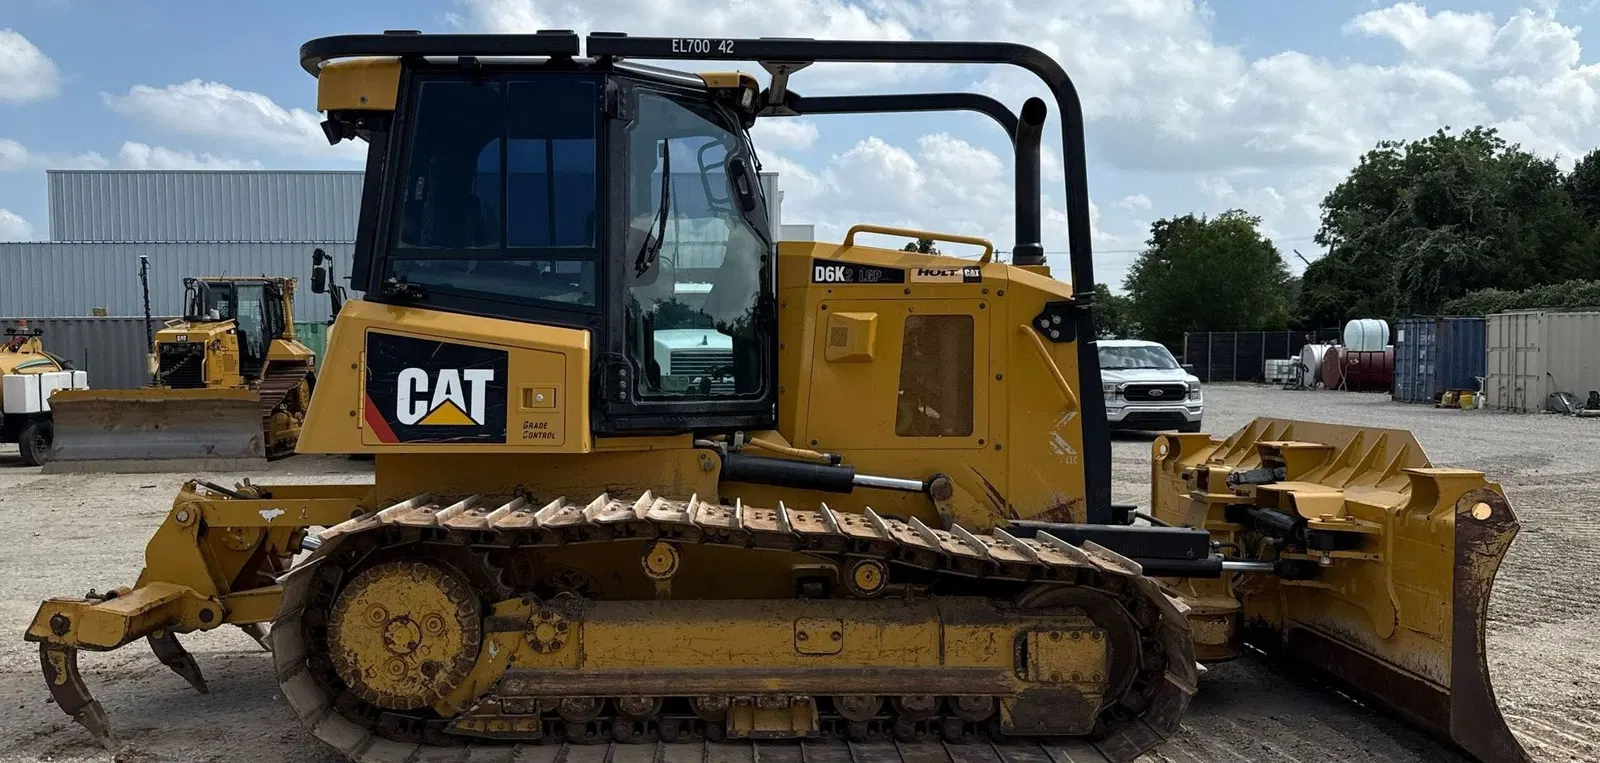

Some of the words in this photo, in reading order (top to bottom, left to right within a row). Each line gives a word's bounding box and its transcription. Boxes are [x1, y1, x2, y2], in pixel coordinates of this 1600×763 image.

[672, 39, 710, 53] EL700
[718, 39, 734, 54] 42
[917, 268, 959, 276] HOLT
[964, 269, 979, 277] CAT
[396, 367, 495, 426] CAT
[523, 420, 548, 429] GRADE
[523, 430, 556, 440] CONTROL
